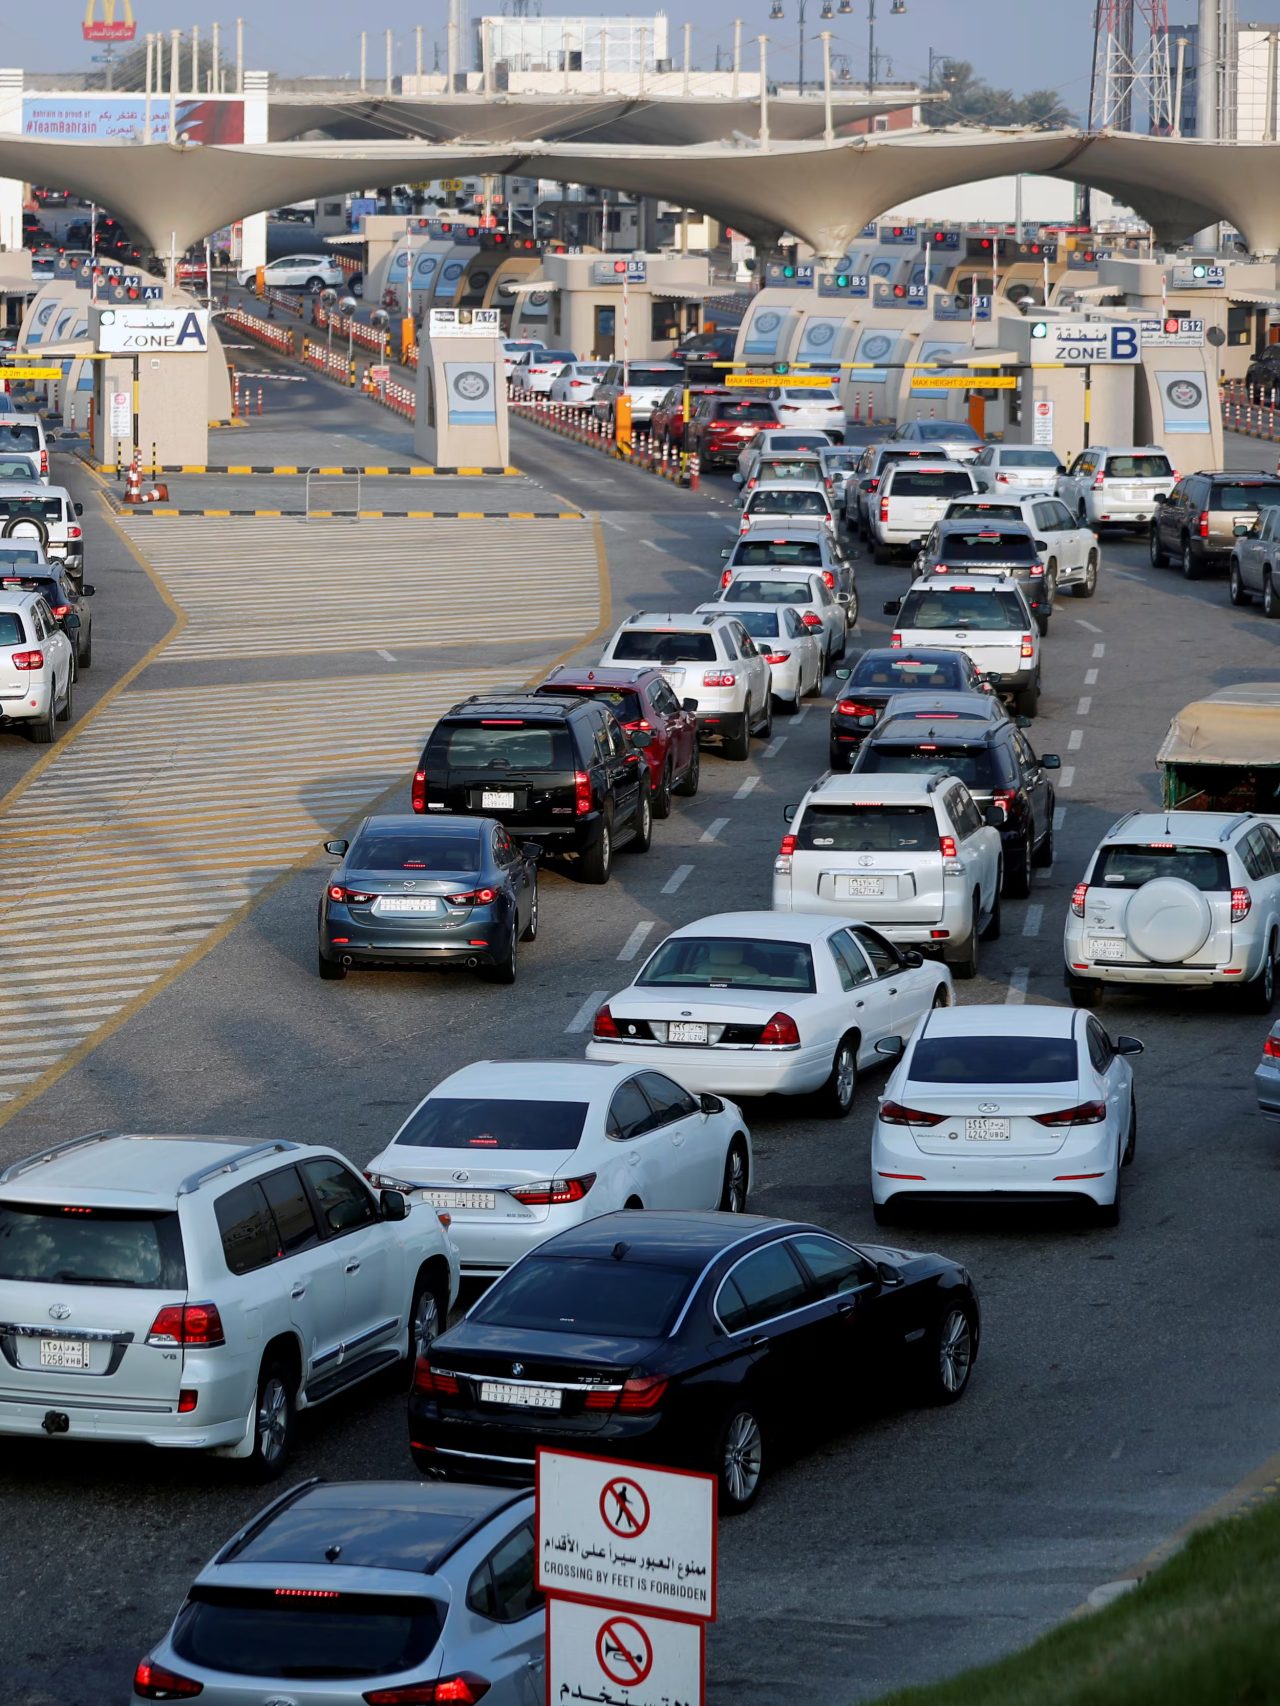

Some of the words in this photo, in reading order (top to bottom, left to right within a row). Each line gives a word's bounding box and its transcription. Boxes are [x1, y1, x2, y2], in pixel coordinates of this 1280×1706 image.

[32, 110, 56, 118] Bahrain
[57, 110, 63, 118] is
[64, 110, 82, 119] proud
[84, 110, 91, 118] of
[26, 120, 97, 133] #TeamBahrain
[107, 267, 121, 276] A3
[629, 262, 643, 272] B5
[797, 267, 811, 277] B4
[1208, 268, 1223, 277] C5
[124, 278, 139, 287] A2
[852, 276, 866, 286] B3
[144, 288, 160, 299] A1
[909, 286, 924, 296] B2
[476, 311, 495, 322] A12
[123, 335, 175, 347] ZONE
[176, 312, 206, 345] A
[1182, 321, 1202, 331] B12
[1055, 327, 1107, 342] منطقة
[1055, 347, 1107, 359] ZONE
[1111, 326, 1138, 360] B
[673, 1032, 685, 1041] 722
[968, 1131, 987, 1139] 4242
[42, 1353, 63, 1365] 1258
[65, 1357, 81, 1365] VHB
[487, 1393, 512, 1403] 1997
[534, 1396, 554, 1406] DZJ
[544, 1533, 579, 1553] الأقدام
[581, 1542, 606, 1560] على
[639, 1556, 675, 1572] العبور
[677, 1560, 706, 1580] ممنوع
[544, 1560, 593, 1581] CROSSING
[596, 1570, 608, 1584] BY
[611, 1573, 635, 1588] FEET
[637, 1578, 647, 1591] IS
[650, 1580, 707, 1601] FORBIDDEN
